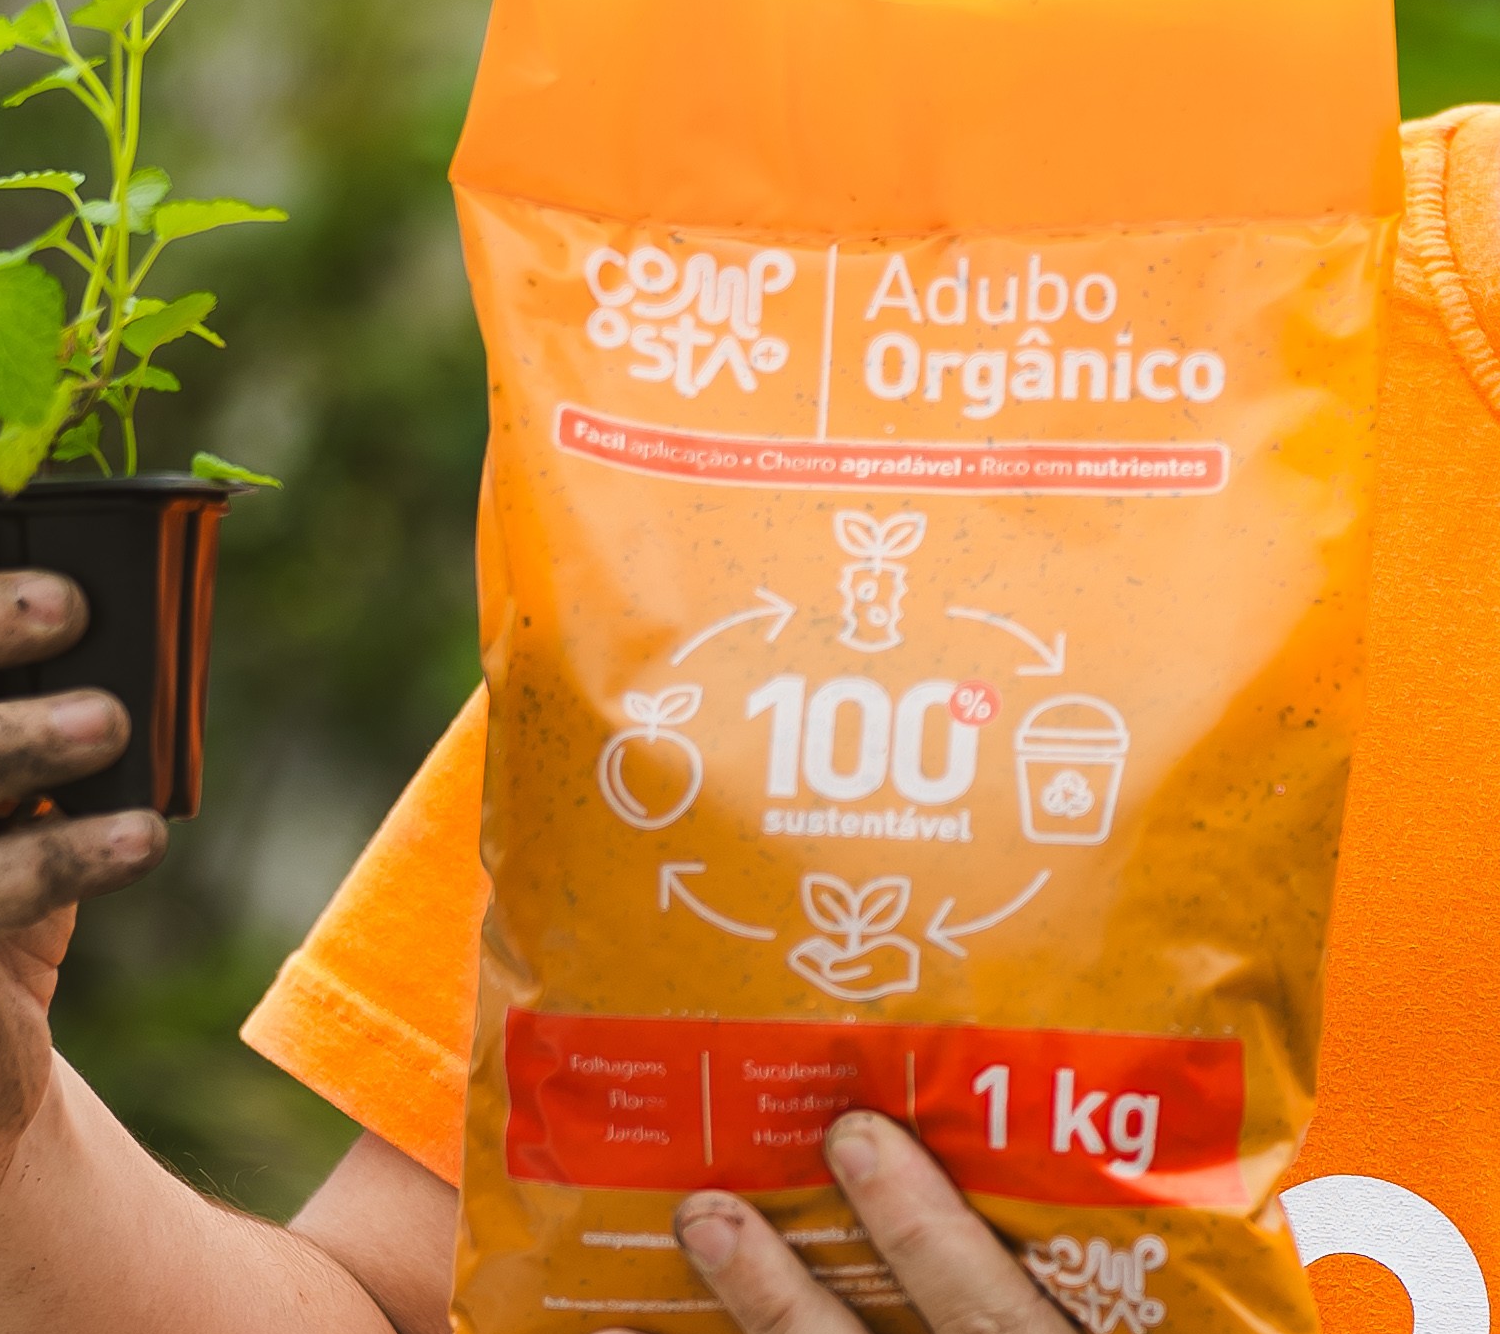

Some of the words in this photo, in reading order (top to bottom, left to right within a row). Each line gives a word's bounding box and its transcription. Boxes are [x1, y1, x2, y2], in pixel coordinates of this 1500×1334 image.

[865, 253, 1118, 325] Adubo
[865, 327, 1227, 420] Orgânico
[629, 440, 738, 471] aplicação
[757, 450, 836, 473] Cheiro
[839, 455, 962, 478] agradável
[980, 458, 1030, 476] Rico
[1033, 460, 1073, 476] em
[1076, 457, 1207, 478] nutrientes
[762, 806, 974, 843] sustentável
[752, 1126, 824, 1147] Hortal
[973, 1064, 1010, 1150] 1
[1053, 1067, 1161, 1178] kg
